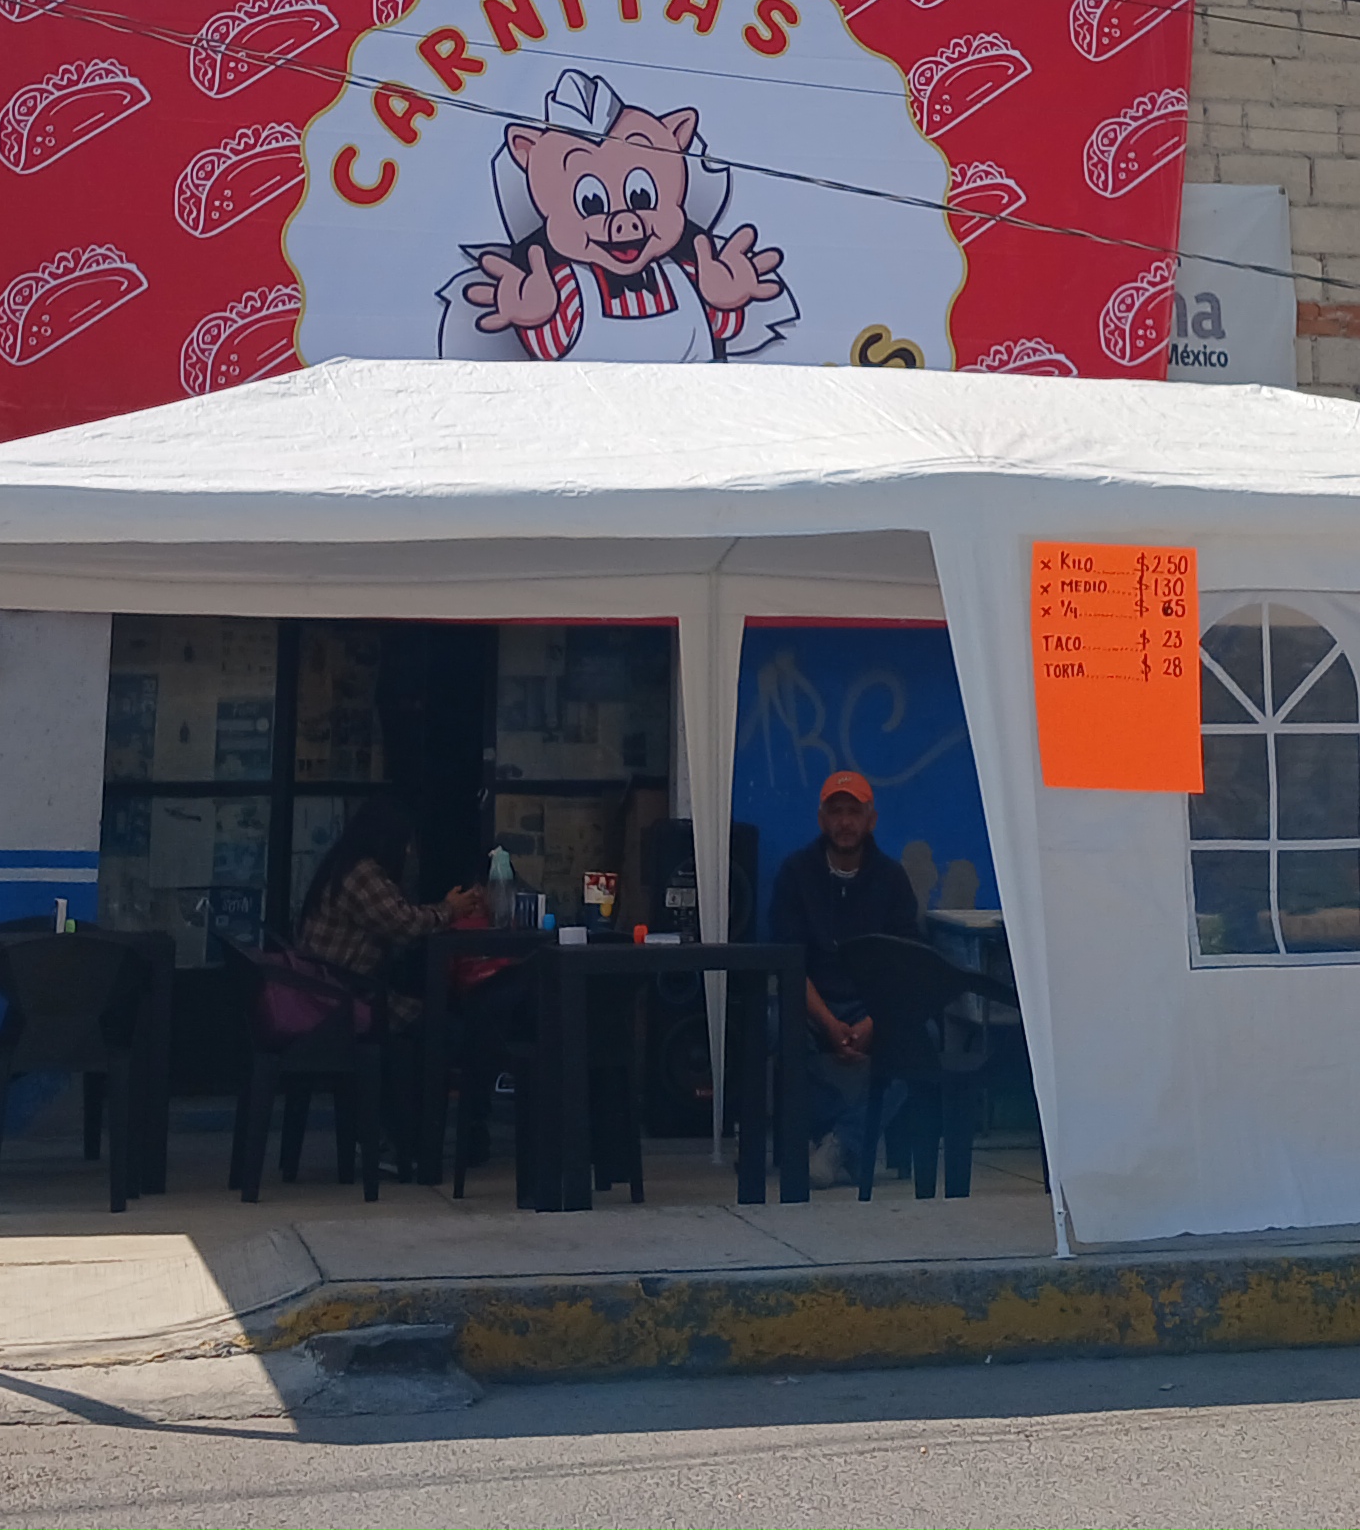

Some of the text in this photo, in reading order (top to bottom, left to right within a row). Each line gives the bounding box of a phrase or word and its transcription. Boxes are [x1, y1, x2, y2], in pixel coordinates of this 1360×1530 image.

[1168, 343, 1228, 368] México
[1060, 579, 1108, 594] MEDIO
[1043, 635, 1082, 652] TACO
[1044, 662, 1085, 679] TORTA
